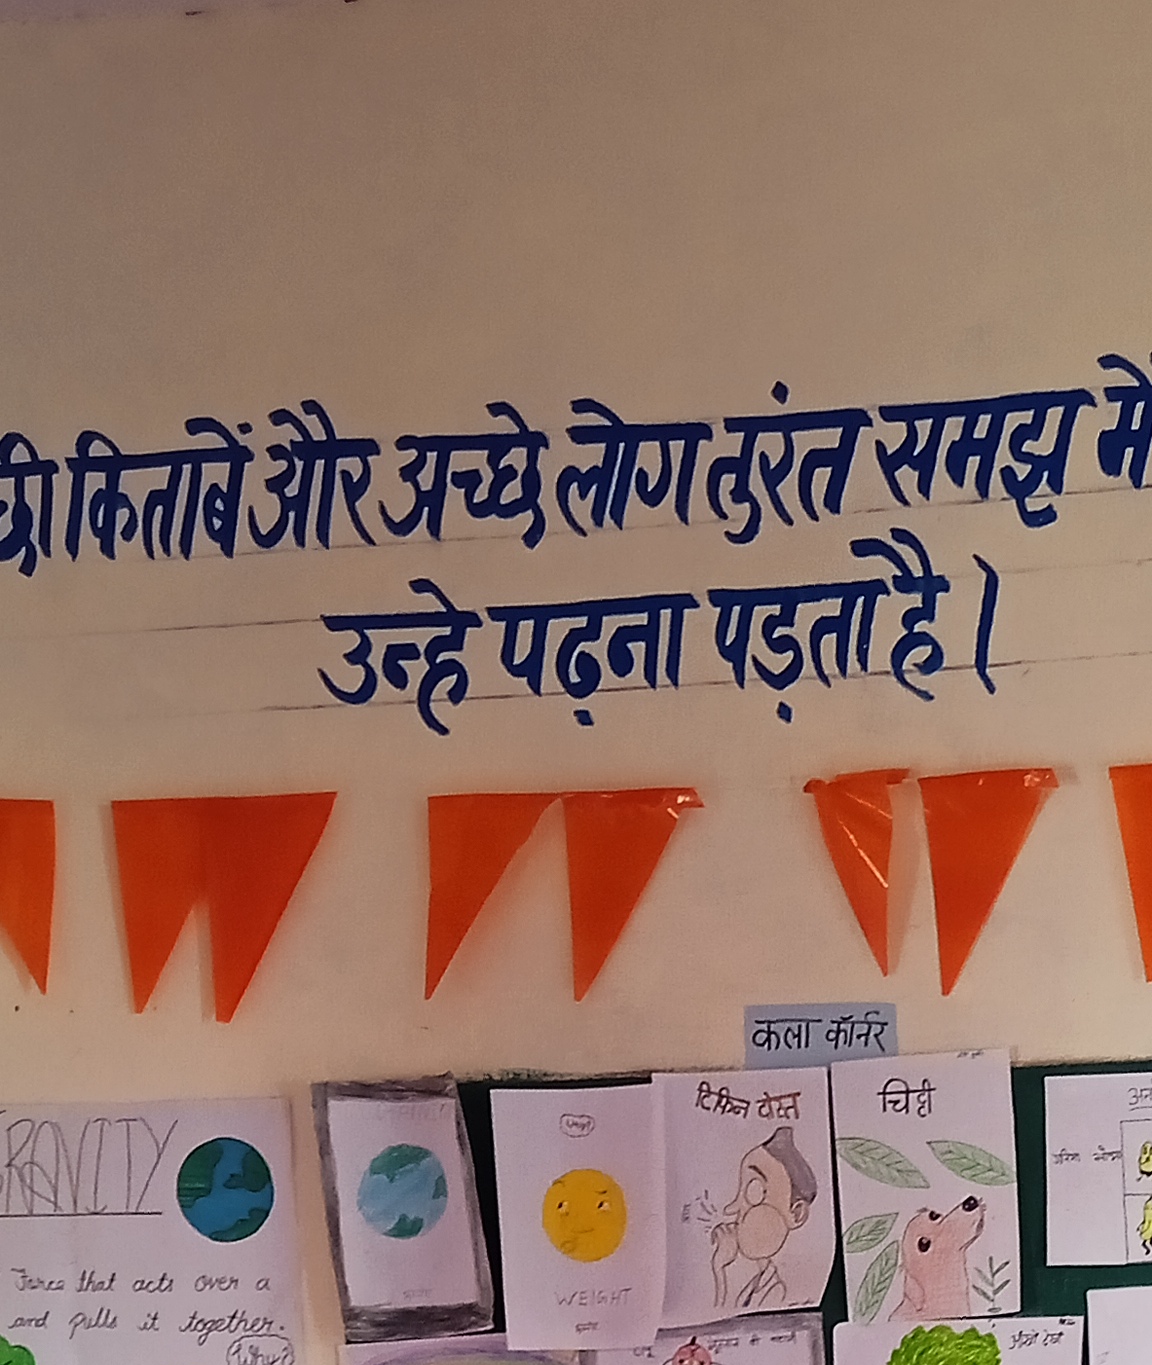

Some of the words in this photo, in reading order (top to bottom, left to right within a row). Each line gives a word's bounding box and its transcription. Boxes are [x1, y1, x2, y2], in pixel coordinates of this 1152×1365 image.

[66, 417, 254, 562] किताबें
[248, 400, 380, 549] और
[378, 401, 549, 549] अच्छे
[556, 399, 713, 536] लोग
[706, 381, 872, 544] तुरंत
[874, 388, 1096, 528] समझ
[319, 579, 482, 736] उन्हे
[487, 593, 700, 727] पढ़ना
[707, 581, 890, 723] पड़ता
[752, 1017, 822, 1051] कला
[826, 1011, 888, 1052] कॉर्नर
[76, 1269, 117, 1292] that
[132, 1272, 174, 1293] acts
[194, 1274, 238, 1292] over
[255, 1277, 271, 1291] a
[8, 1310, 50, 1329] and
[68, 1307, 118, 1339] pulls
[137, 1311, 159, 1331] it
